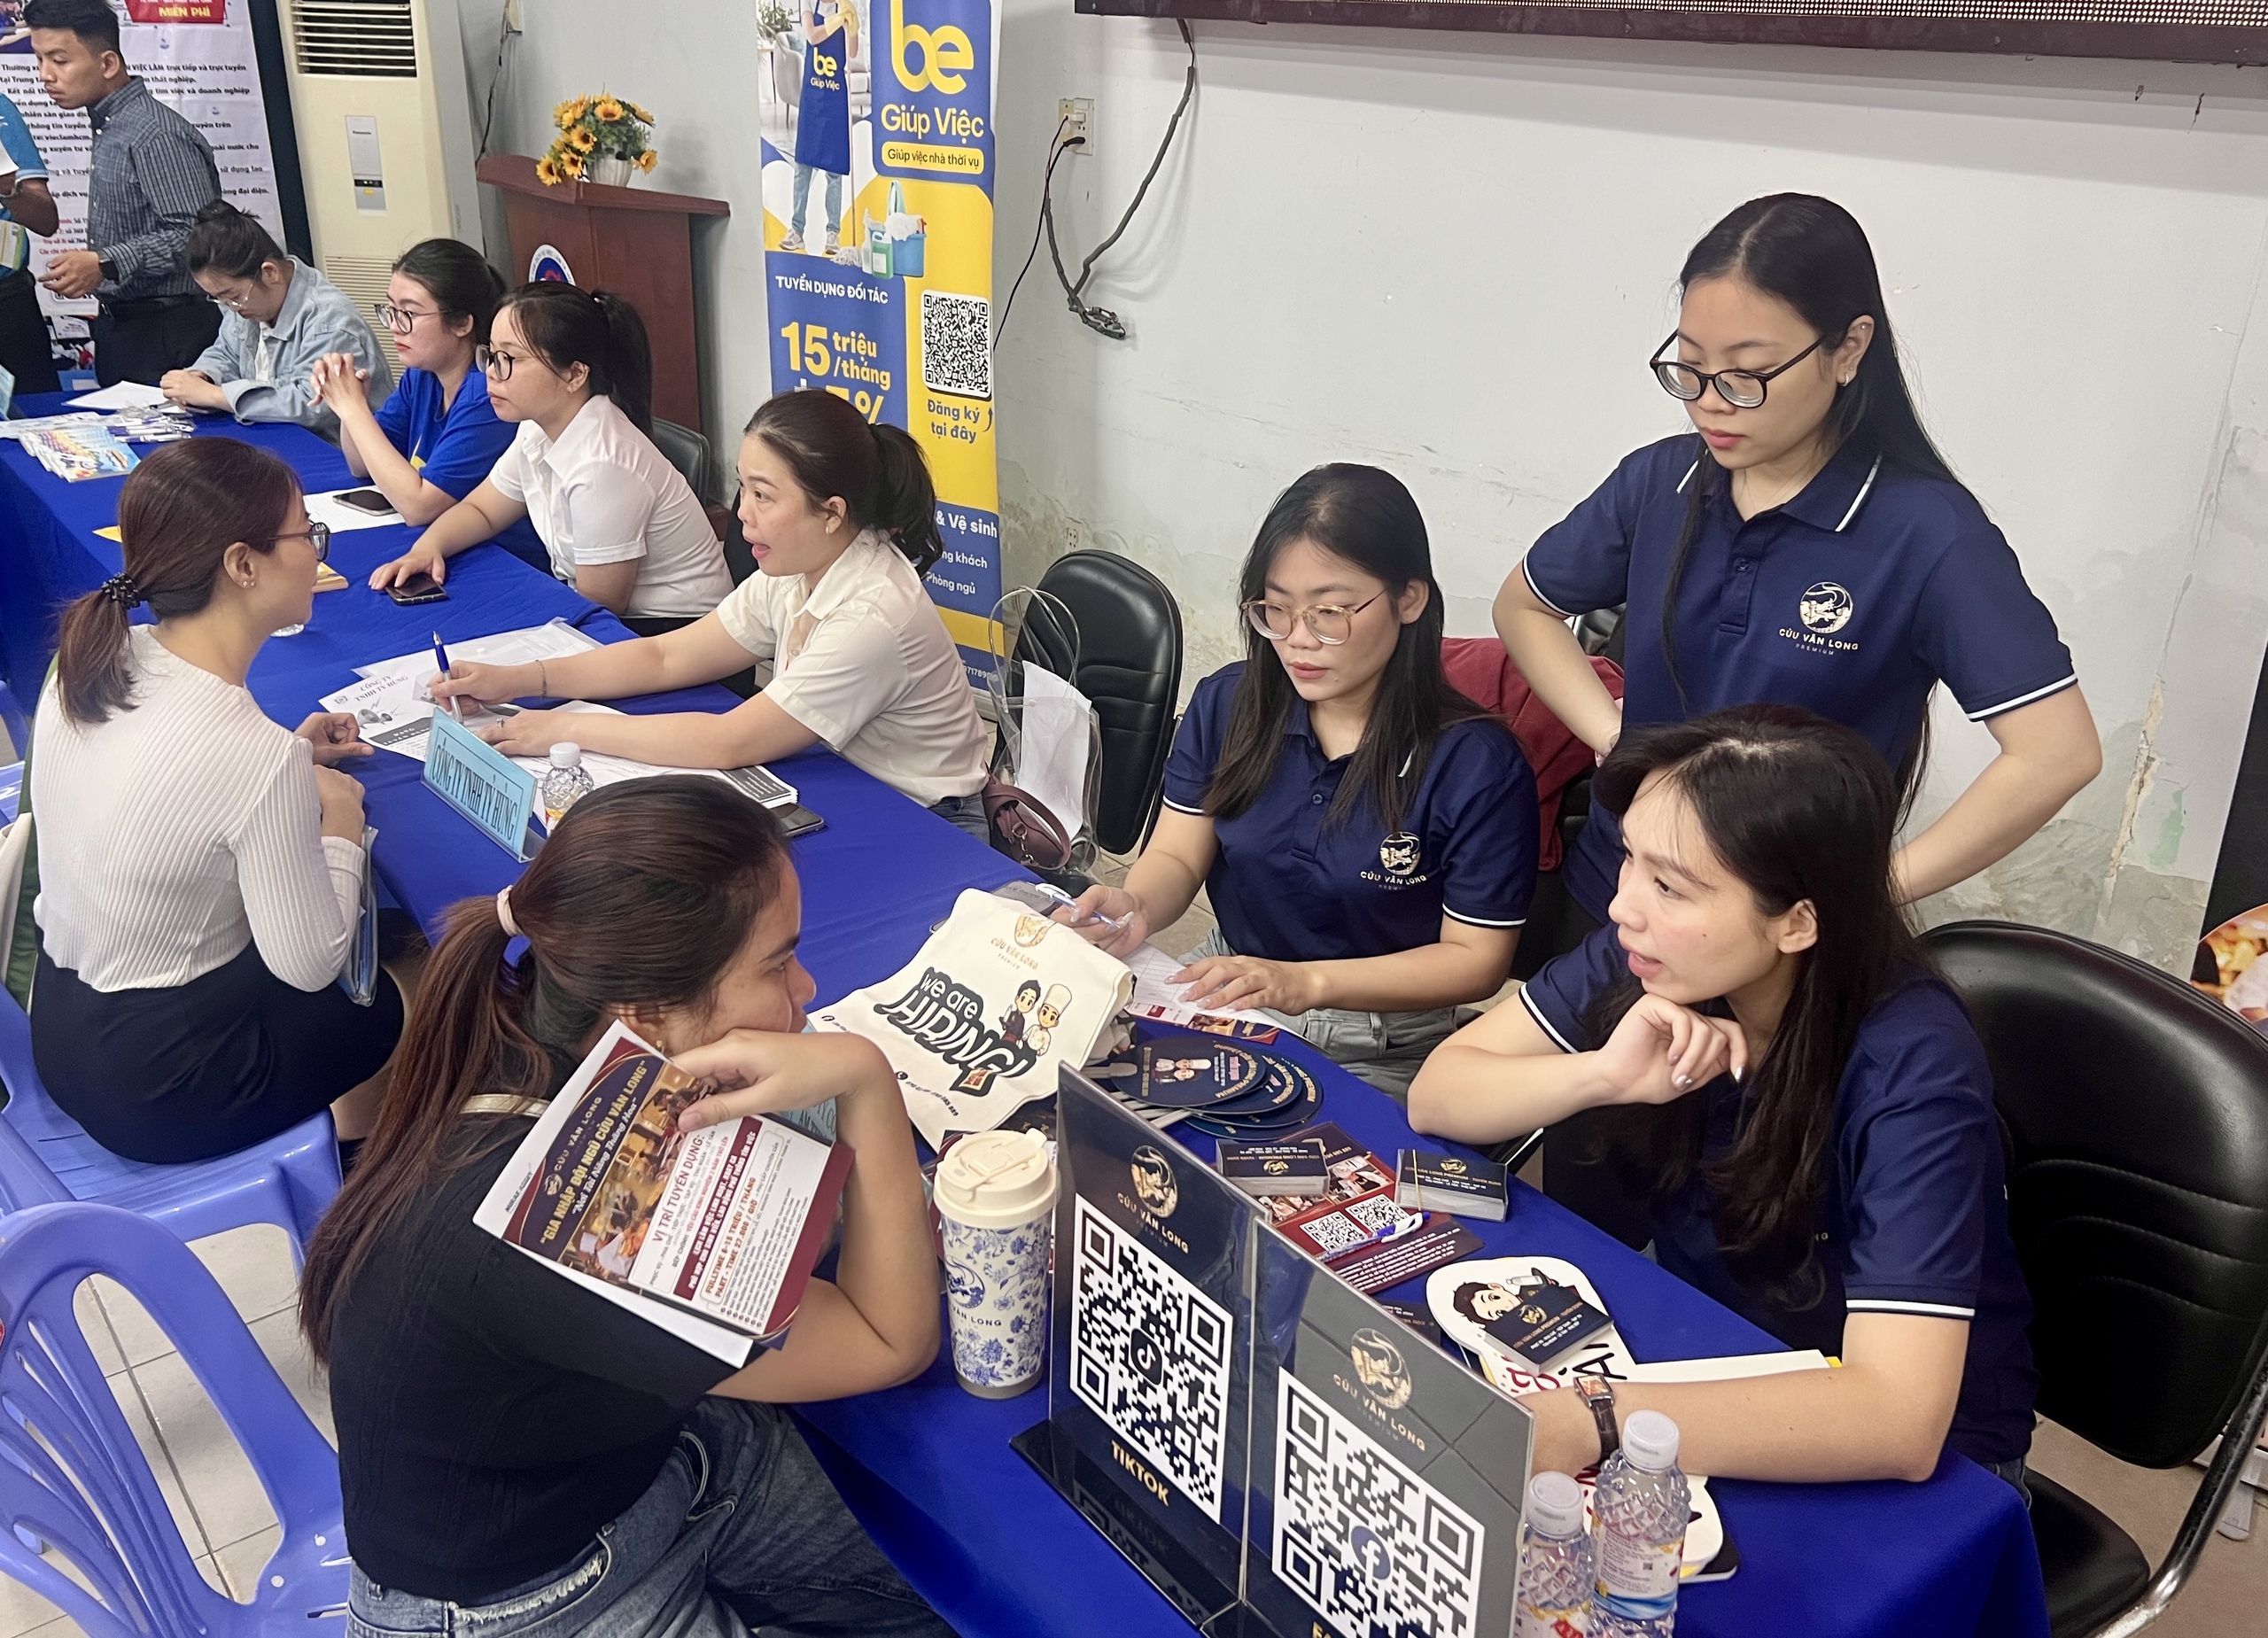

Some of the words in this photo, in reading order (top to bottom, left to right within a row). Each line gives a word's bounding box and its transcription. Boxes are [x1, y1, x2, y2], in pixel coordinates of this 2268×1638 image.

[812, 46, 837, 78] be
[889, 0, 974, 95] be
[810, 76, 825, 89] Giúp
[825, 78, 840, 91] Việc
[881, 104, 931, 140] Giúp
[937, 107, 984, 144] Việc
[887, 147, 911, 163] Giúp
[912, 149, 928, 165] việc
[928, 149, 945, 165] nhà
[947, 150, 971, 167] thời
[971, 153, 980, 167] vụ
[775, 274, 812, 293] TUYỂN
[813, 281, 845, 299] DỤNG
[847, 283, 867, 301] ĐỐI
[867, 285, 889, 304] TÁC
[781, 321, 831, 377] 15
[832, 330, 877, 359] triệu
[833, 354, 891, 391] /tháng
[927, 399, 960, 422] Đăng
[963, 406, 981, 423] ký
[931, 422, 947, 439] tại
[950, 426, 976, 444] đây
[936, 510, 945, 527] &
[948, 513, 967, 531] Vệ
[970, 517, 998, 539] sinh
[954, 550, 988, 569] khách
[926, 571, 955, 592] Phòng
[956, 576, 976, 595] ngủ
[1795, 643, 1834, 656] PREMIUM
[1803, 633, 1825, 646] VÂN
[1828, 639, 1859, 650] LONG
[451, 758, 465, 799] TY
[460, 765, 485, 816] TNHH
[1384, 875, 1403, 885] VÂN
[1405, 874, 1427, 885] LONG
[920, 973, 947, 998] we
[945, 989, 979, 1020] are
[606, 1091, 629, 1118] VÂN
[565, 1124, 584, 1147] VÂN
[579, 1094, 602, 1125] LONG
[578, 1137, 602, 1166] NGŨ
[589, 1149, 612, 1178] Năng
[603, 1120, 627, 1152] Thăng
[682, 1133, 707, 1170] DỤNG:
[566, 1162, 591, 1187] ĐỘI
[548, 1184, 580, 1220] NHẬP
[656, 1207, 674, 1229] TRÍ
[1140, 1206, 1158, 1231] VÂN
[1161, 1224, 1188, 1254] LONG
[652, 1229, 667, 1244] VỊ
[704, 1254, 726, 1294] FULLTIME
[738, 1176, 756, 1204] THÁNG
[714, 1276, 728, 1298] PART
[725, 1248, 738, 1269] TIME
[971, 1316, 1002, 1326] LONG
[1362, 1392, 1386, 1422] VÂN
[1390, 1416, 1425, 1453] LONG
[1111, 1440, 1169, 1507] TIKTOK
